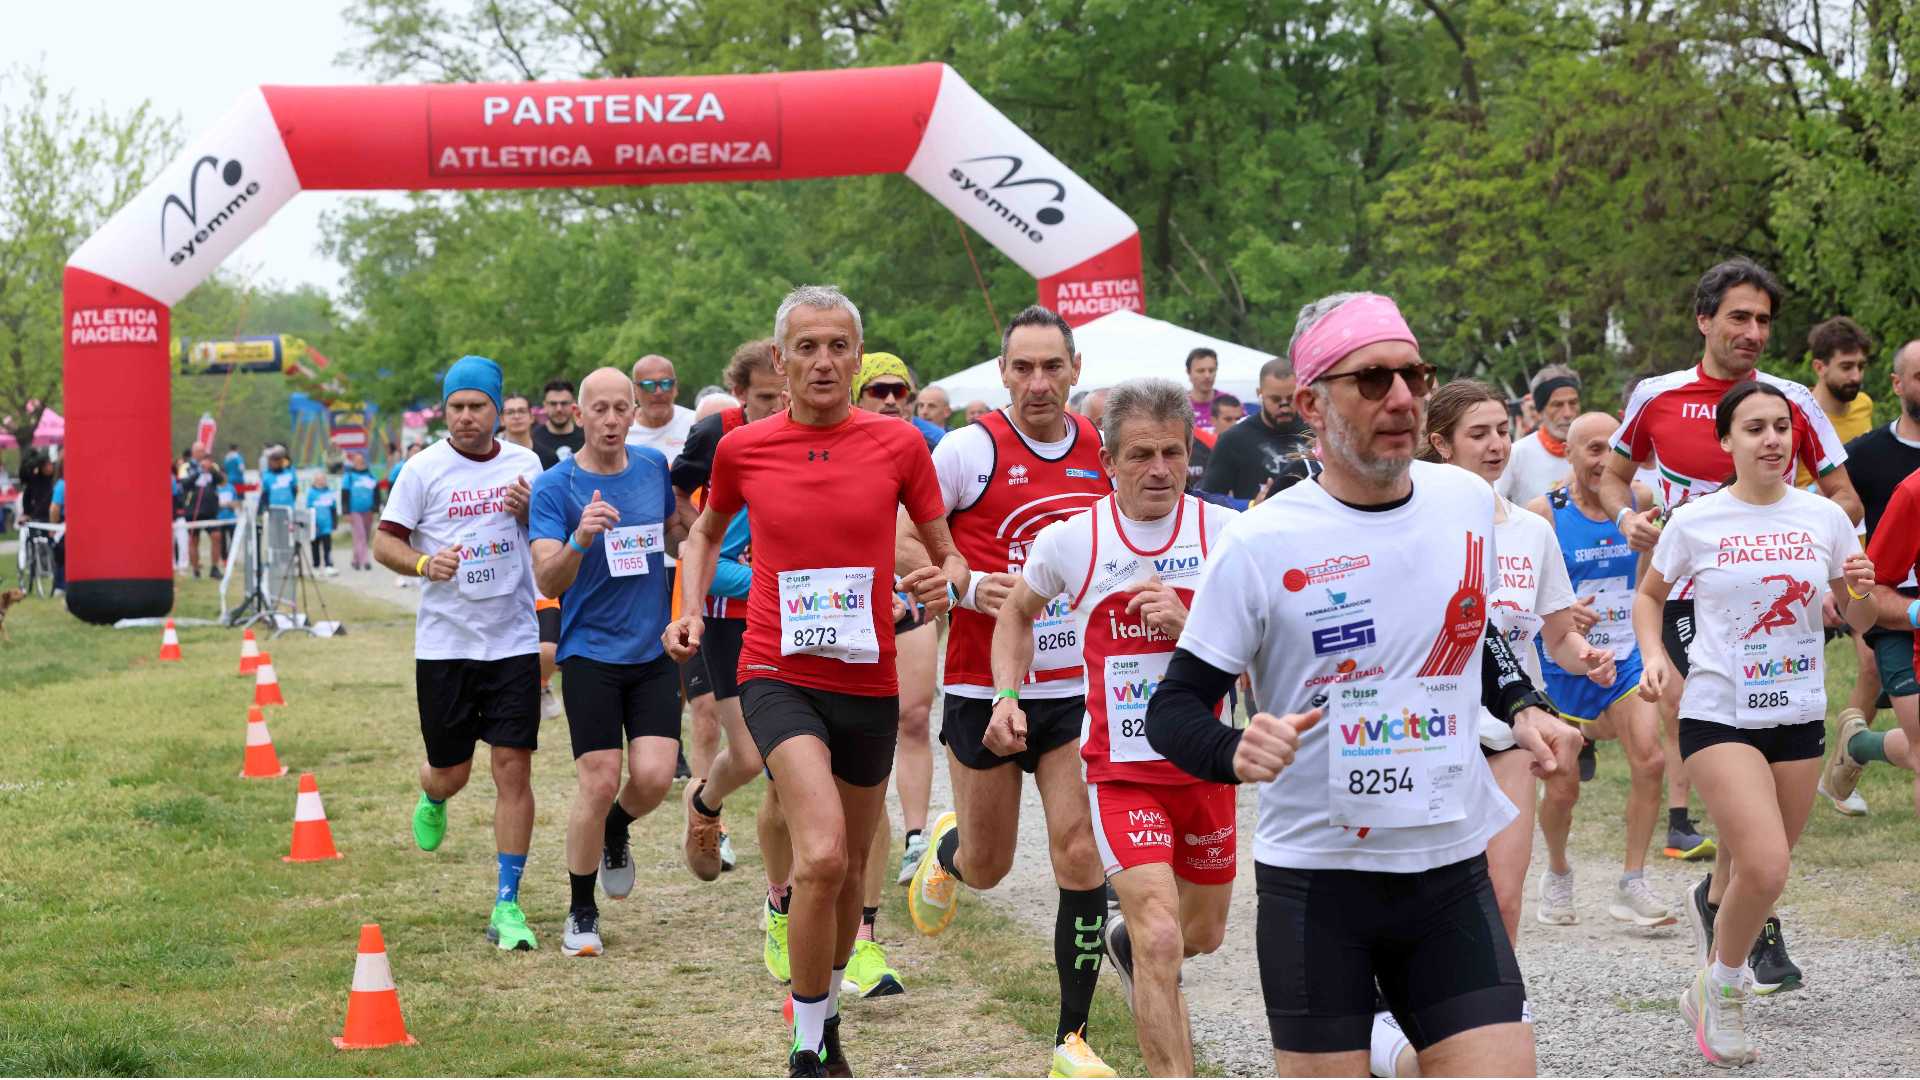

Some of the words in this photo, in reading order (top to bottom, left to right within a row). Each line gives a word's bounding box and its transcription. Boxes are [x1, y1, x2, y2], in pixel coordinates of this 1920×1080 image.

[484, 92, 726, 126] PARTENZA
[438, 145, 593, 169] ATLETICA
[614, 141, 773, 165] PIACENZA
[948, 168, 1044, 244] syemme
[169, 181, 261, 267] syemme
[1057, 279, 1140, 299] ATLETICA
[1057, 297, 1140, 315] PIACENZA
[71, 308, 158, 327] ATLETICA
[71, 325, 158, 344] PIACENZA
[1682, 402, 1717, 419] ITAL
[450, 486, 508, 503] ATLETIC
[448, 502, 504, 519] PIACEN
[1719, 531, 1814, 550] ATLETICA
[613, 557, 644, 571] 17655
[1497, 556, 1534, 571] TICA
[1717, 546, 1817, 567] PIACENZA
[467, 568, 496, 584] 8291
[787, 587, 858, 615] vivicittà
[794, 626, 837, 646] 8273
[1038, 630, 1076, 651] 8266
[1312, 618, 1376, 655] ESI
[1584, 633, 1610, 646] 278
[1121, 661, 1139, 669] UISP
[1743, 654, 1810, 680] vivicittà
[1304, 672, 1354, 688] COMFORT
[1355, 665, 1385, 680] ITALIA
[1113, 675, 1165, 703] vivic
[1353, 688, 1378, 699] UISP
[1426, 683, 1458, 693] HARSH
[1115, 703, 1147, 711] includer
[1748, 690, 1790, 709] 8285
[1121, 718, 1146, 738] 82
[1340, 707, 1447, 747] vivicittà
[1448, 714, 1457, 737] 2026
[1342, 746, 1392, 758] includere
[1348, 766, 1414, 795] 8254
